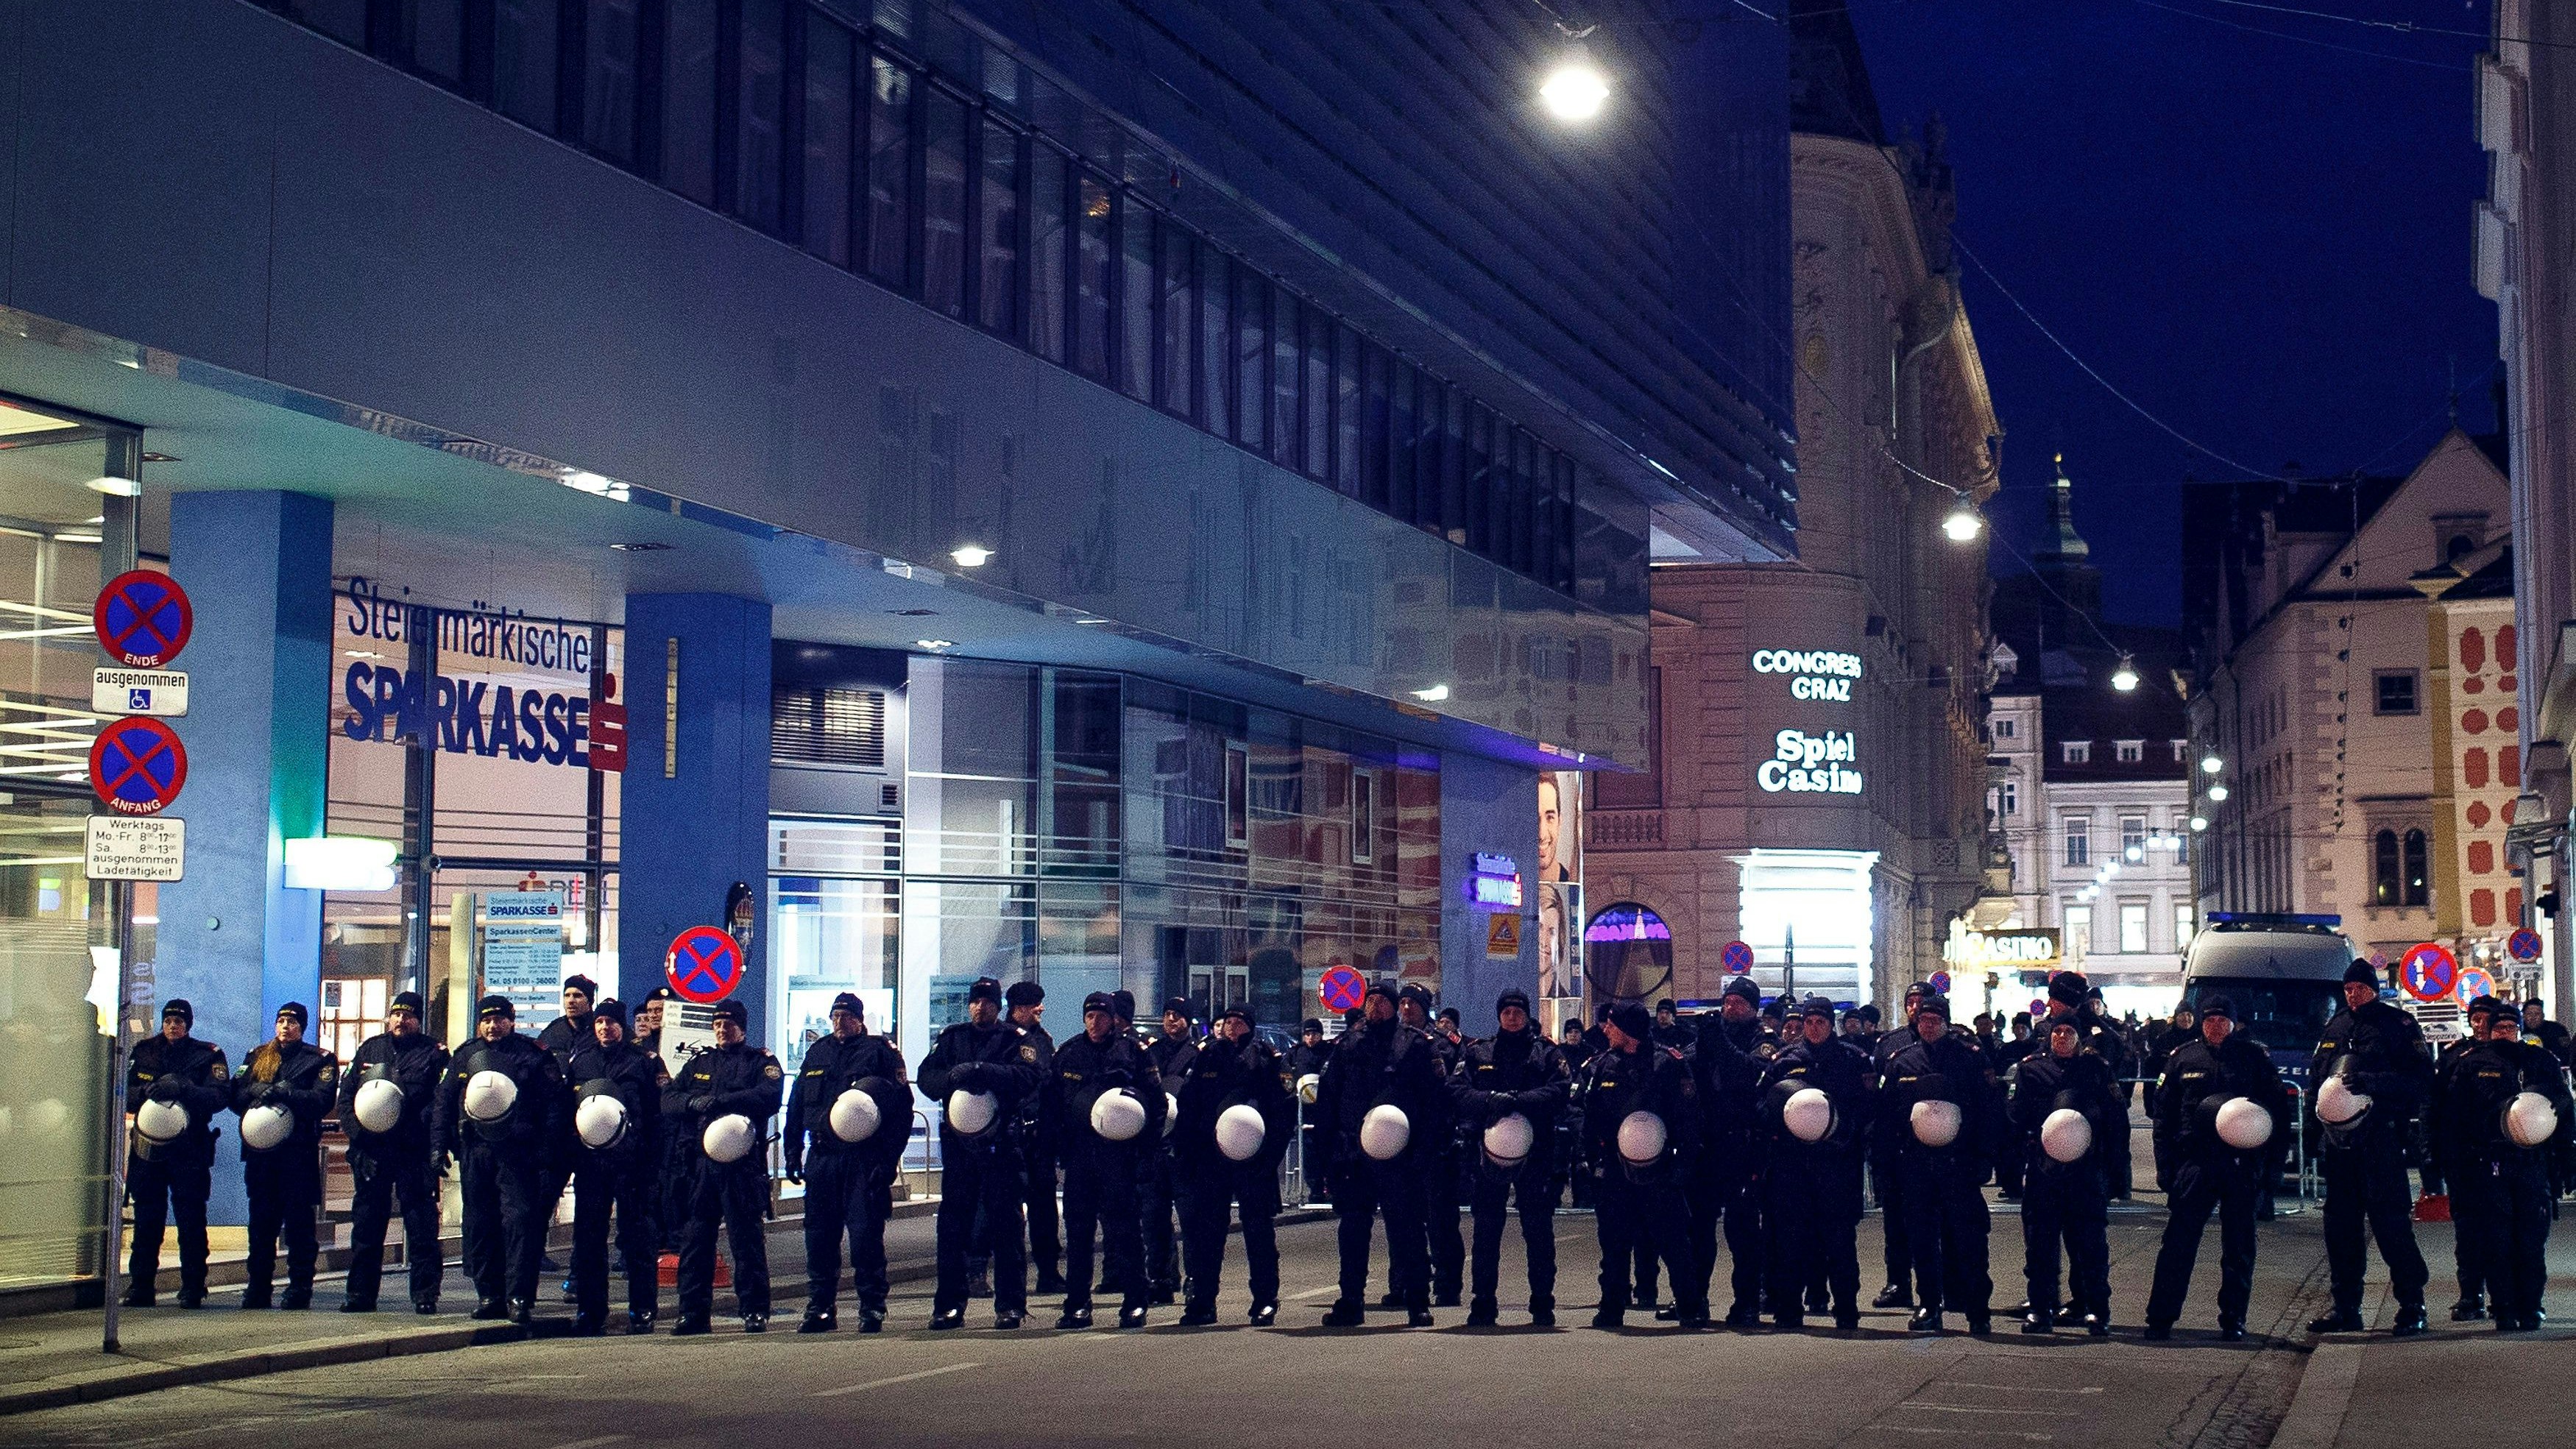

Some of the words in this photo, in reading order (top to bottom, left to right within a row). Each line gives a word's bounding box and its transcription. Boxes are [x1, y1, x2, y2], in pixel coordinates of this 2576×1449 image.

[348, 575, 591, 673] Steiemärkische
[124, 653, 160, 667] ENDE
[1752, 650, 1861, 679] CONGRESS
[96, 672, 185, 689] ausgenommen
[1791, 676, 1850, 702] GRAZ
[343, 661, 589, 768] SPARKASSE
[1776, 729, 1855, 769] Spiel
[110, 797, 162, 813] ANFANG
[110, 819, 165, 832] Werktags
[96, 843, 113, 853] Sa.
[93, 854, 178, 865] ausgenommen
[96, 865, 173, 877] Ladetätigkeit
[490, 906, 547, 916] SPARKASSE
